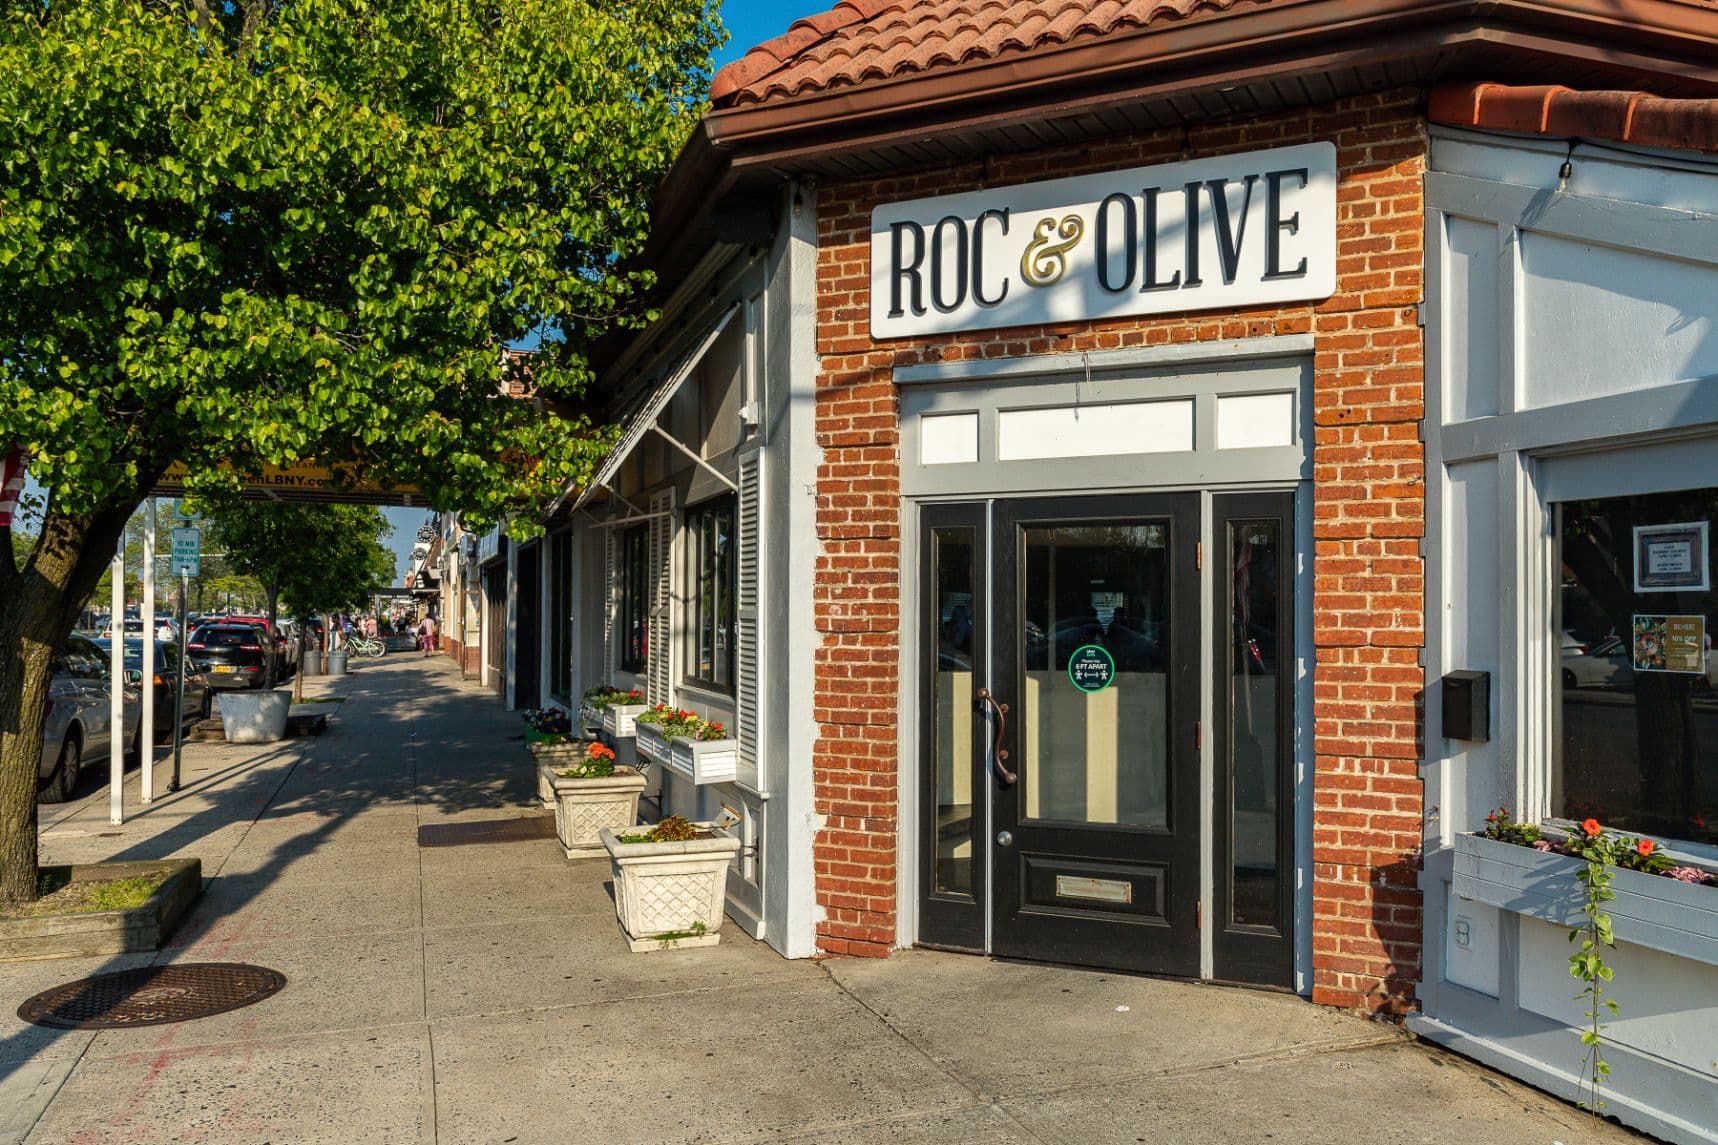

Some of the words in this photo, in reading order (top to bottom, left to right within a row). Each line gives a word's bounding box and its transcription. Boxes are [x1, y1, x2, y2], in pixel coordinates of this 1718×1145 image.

[888, 206, 1010, 319] ROC
[1019, 214, 1085, 288] &
[1095, 167, 1309, 294] OLIVE
[174, 548, 198, 556] PARKING
